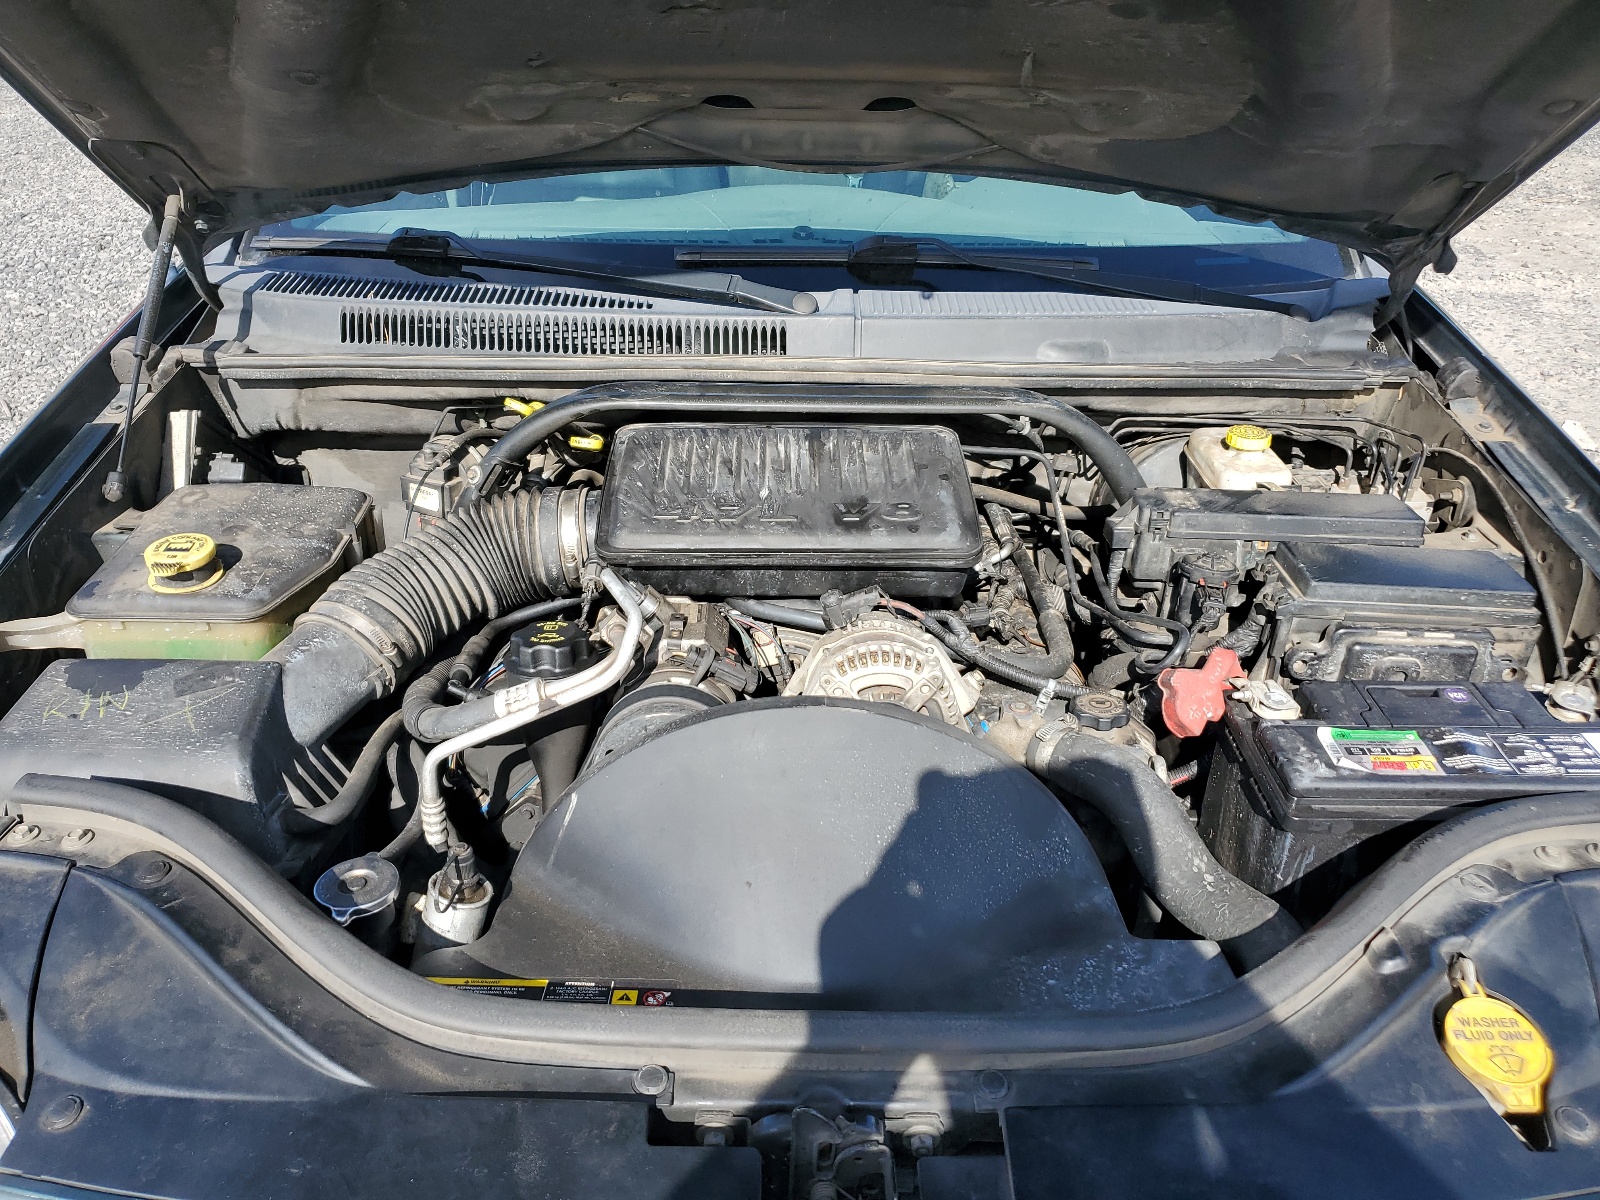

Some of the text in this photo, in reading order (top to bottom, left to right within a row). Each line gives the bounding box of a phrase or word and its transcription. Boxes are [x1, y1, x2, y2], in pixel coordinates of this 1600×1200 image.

[833, 500, 923, 522] V8
[1457, 1017, 1520, 1028] WASHER
[1452, 1029, 1534, 1041] FLUID ONLY
